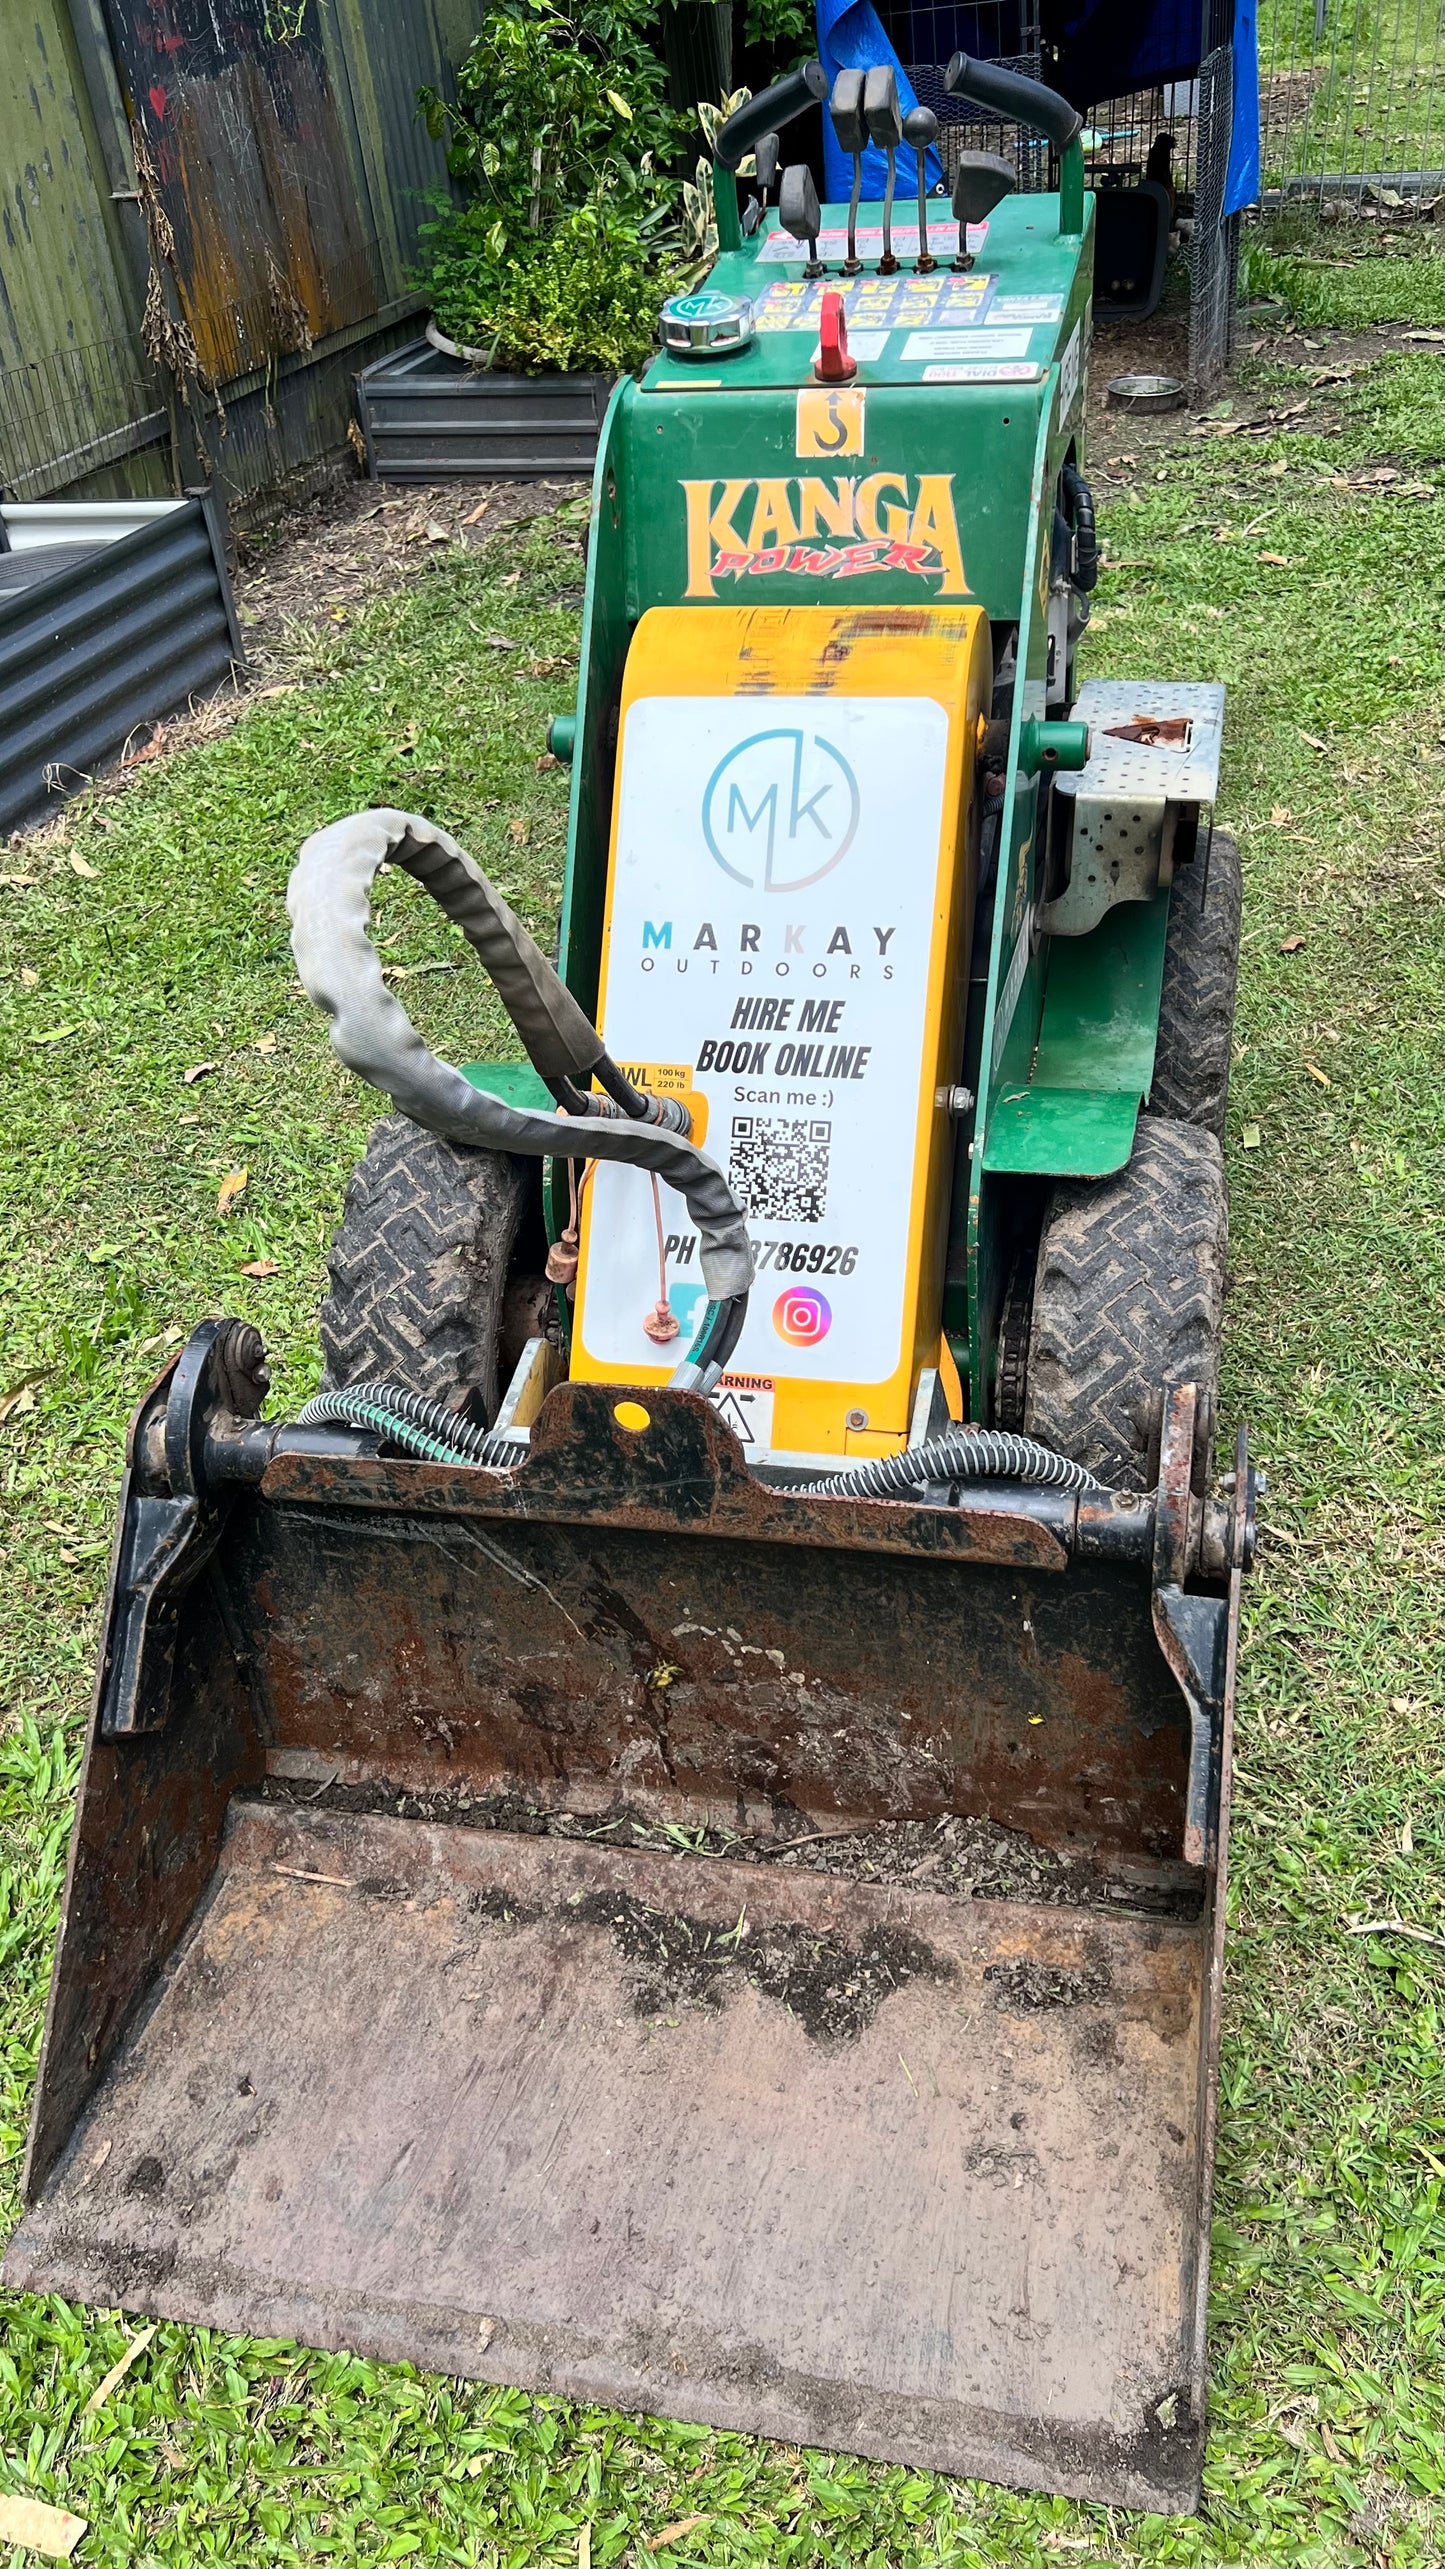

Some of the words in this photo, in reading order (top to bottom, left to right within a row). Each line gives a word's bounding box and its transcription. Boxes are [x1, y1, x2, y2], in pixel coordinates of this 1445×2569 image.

[677, 472, 975, 598] KANGA
[705, 540, 950, 579] POWER
[641, 921, 897, 955] MARKAY
[641, 957, 894, 979] OUTDOORS
[730, 997, 795, 1031] HIRE
[797, 999, 846, 1033] ME
[675, 1070, 685, 1078] kg
[696, 1040, 772, 1074] BOOK
[774, 1043, 872, 1079] ONLINE
[621, 1067, 652, 1086] WL
[734, 1086, 780, 1103] Scan
[786, 1091, 816, 1105] me
[665, 1234, 697, 1264] PH
